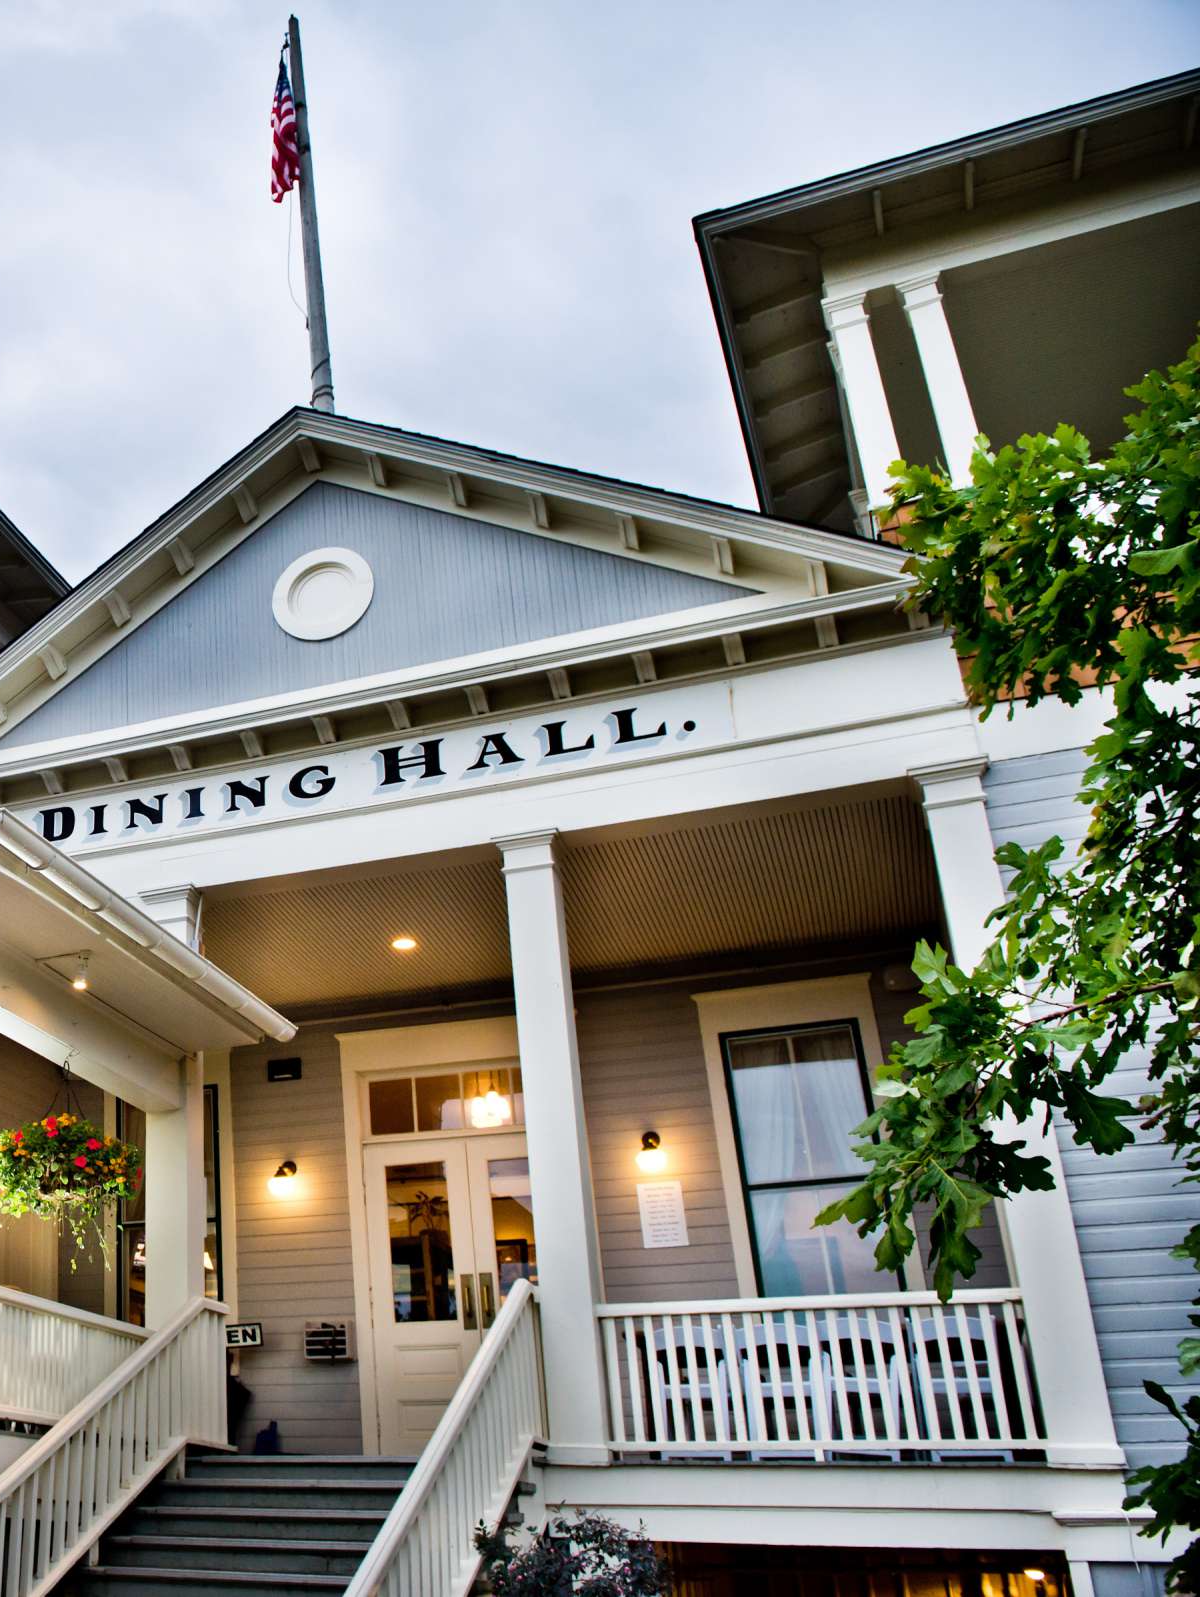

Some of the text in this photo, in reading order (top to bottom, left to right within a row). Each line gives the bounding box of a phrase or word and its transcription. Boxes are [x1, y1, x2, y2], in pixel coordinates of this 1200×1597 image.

[39, 707, 698, 842] DINING HALL.
[226, 1328, 257, 1344] EN
